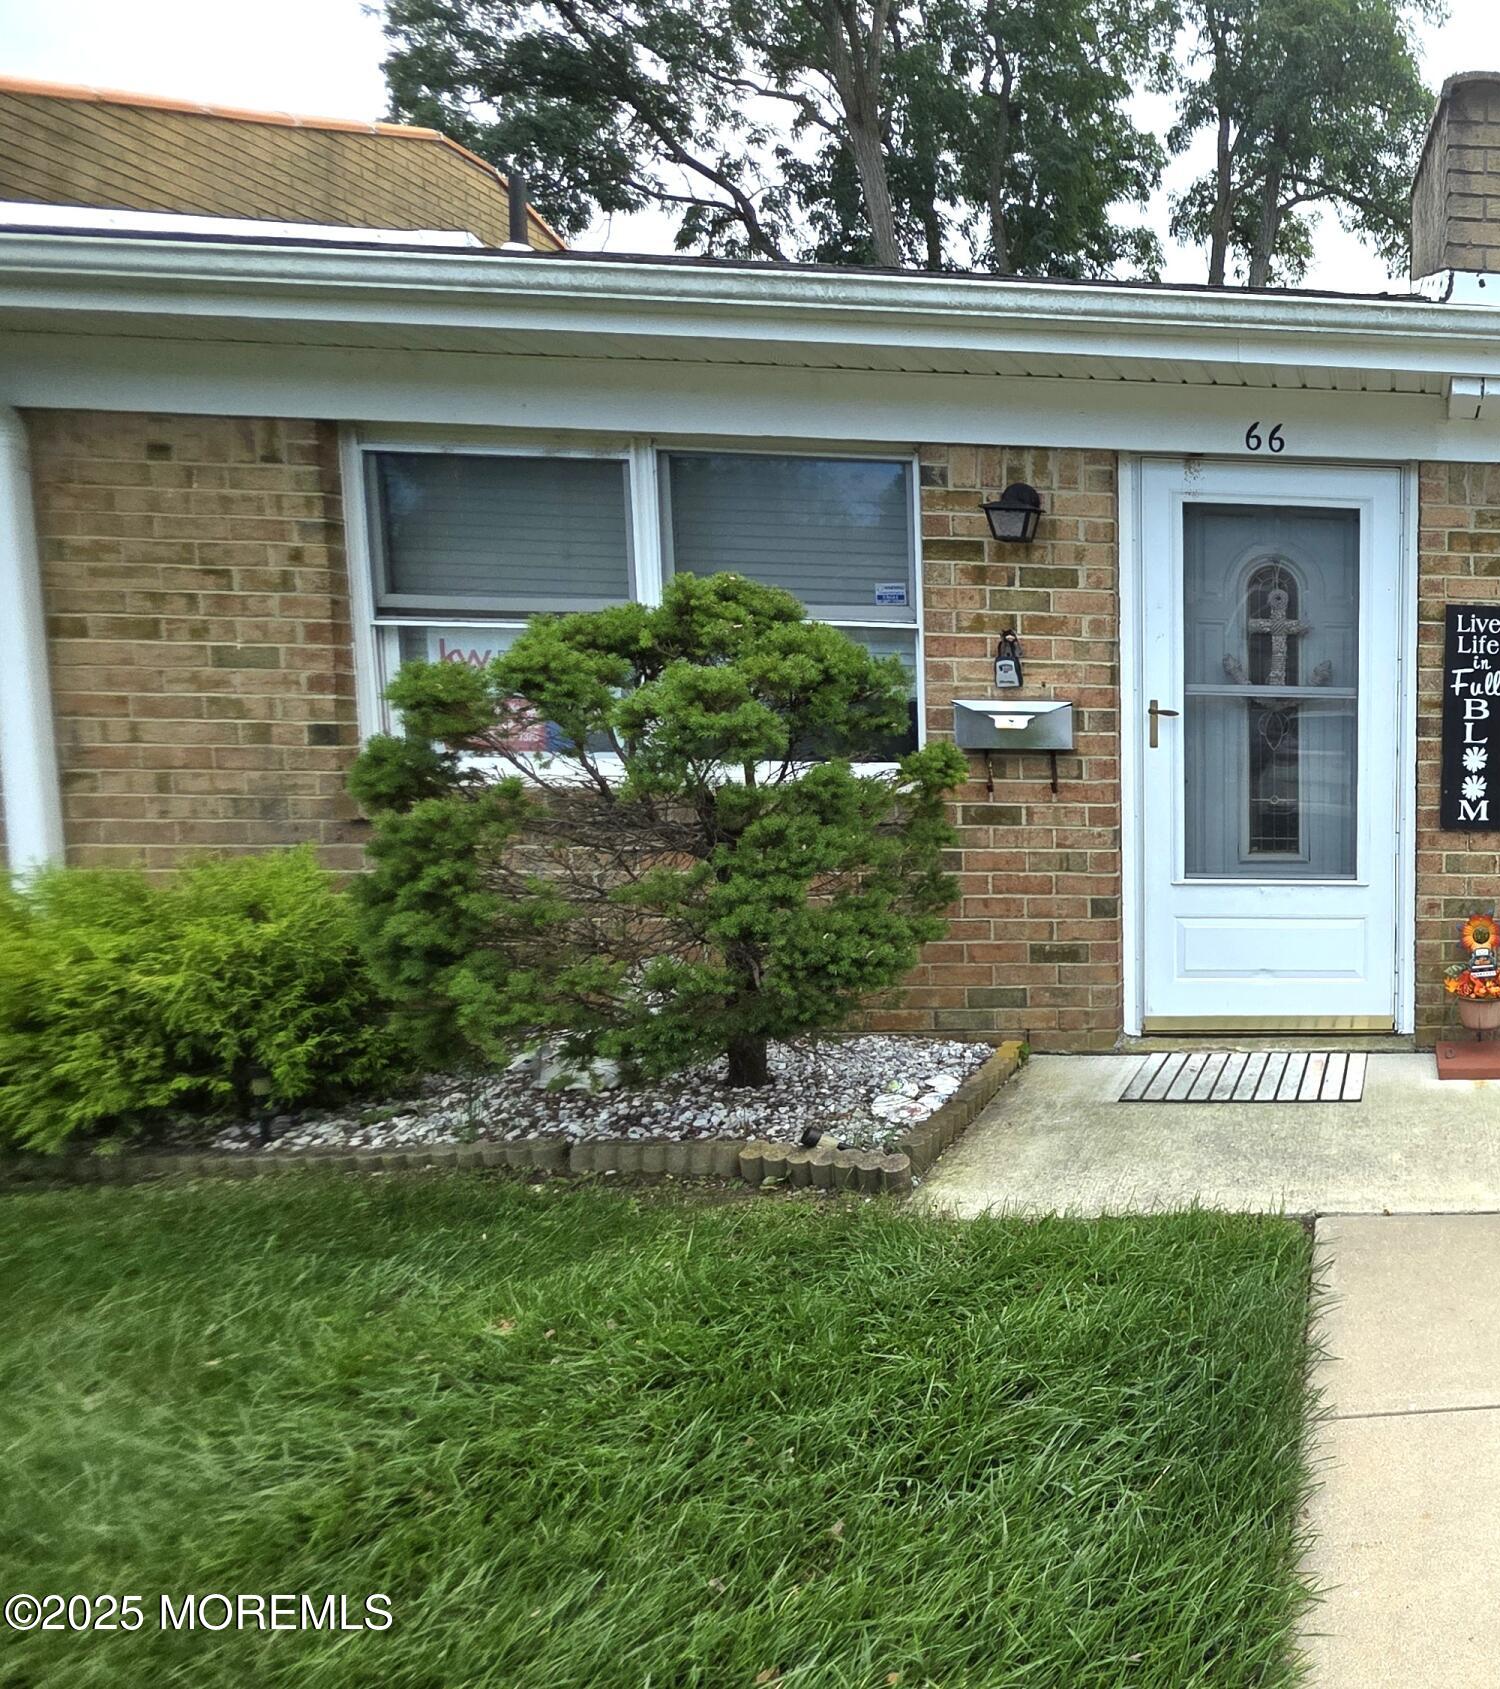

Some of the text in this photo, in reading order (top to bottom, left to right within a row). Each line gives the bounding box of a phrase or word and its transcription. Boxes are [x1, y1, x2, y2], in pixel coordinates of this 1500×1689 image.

[1244, 421, 1285, 453] 66
[1458, 635, 1500, 654] Life
[1473, 655, 1491, 670] in
